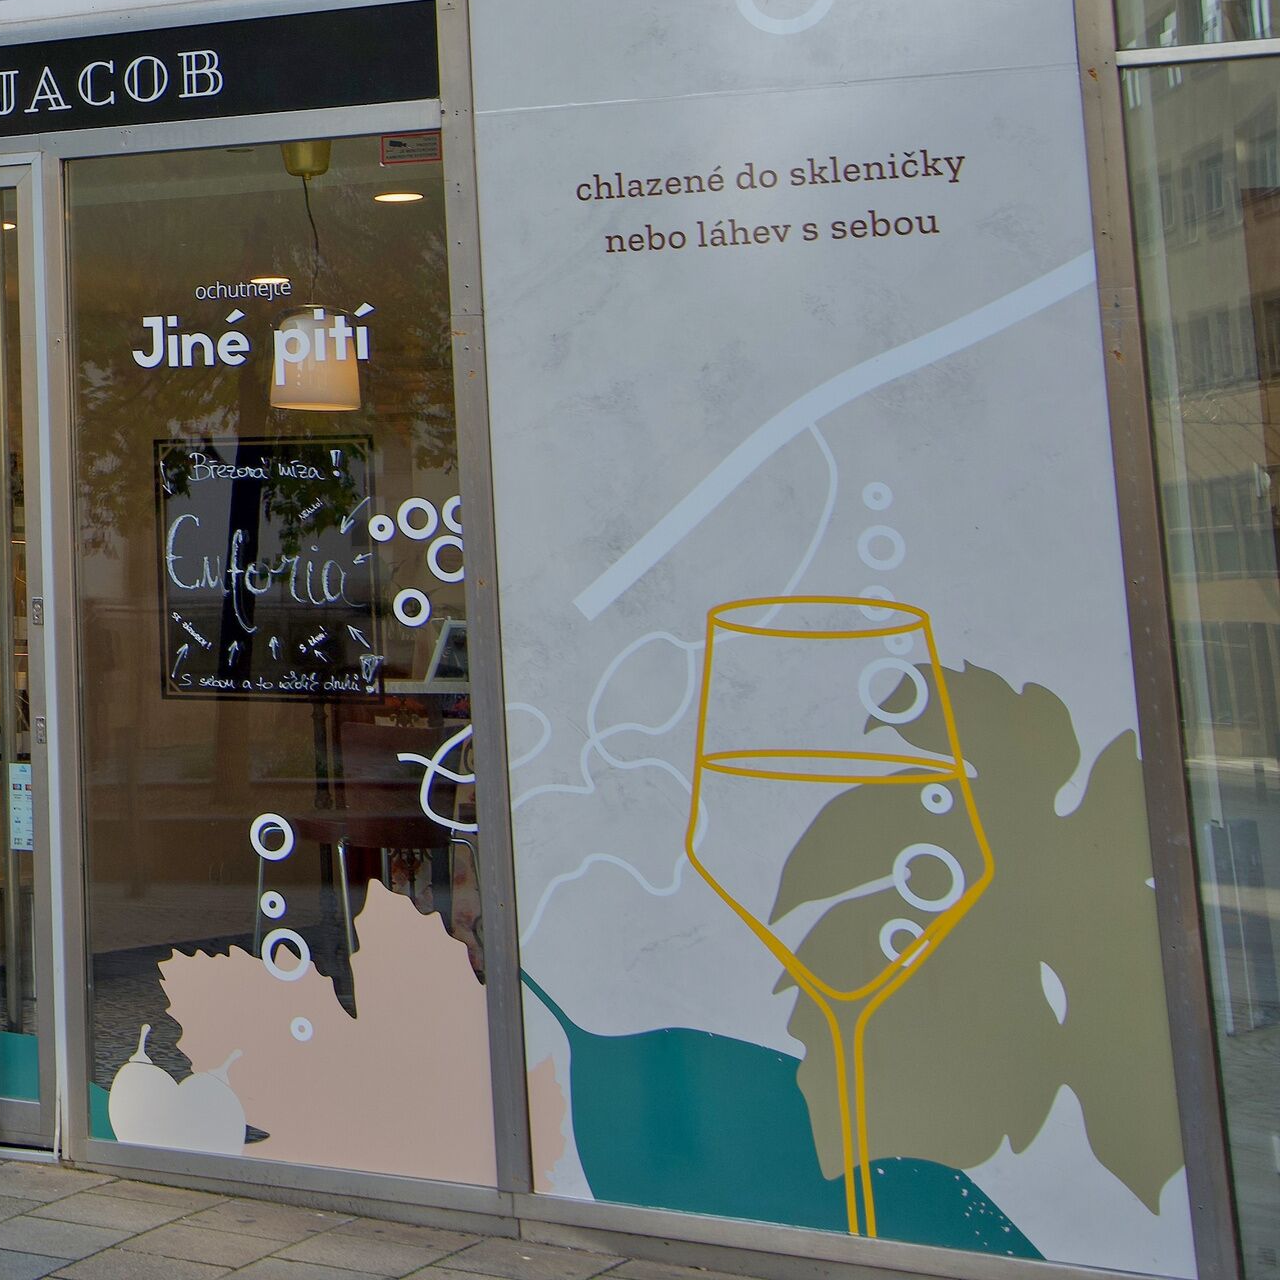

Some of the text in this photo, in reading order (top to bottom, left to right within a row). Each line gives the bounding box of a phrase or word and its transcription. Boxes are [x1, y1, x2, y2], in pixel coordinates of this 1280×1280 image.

[577, 149, 966, 201] chlazené do skleničky
[605, 210, 940, 253] nebo láhev s sebou
[195, 279, 292, 301] ochutnejte
[132, 302, 375, 386] Jiné pití
